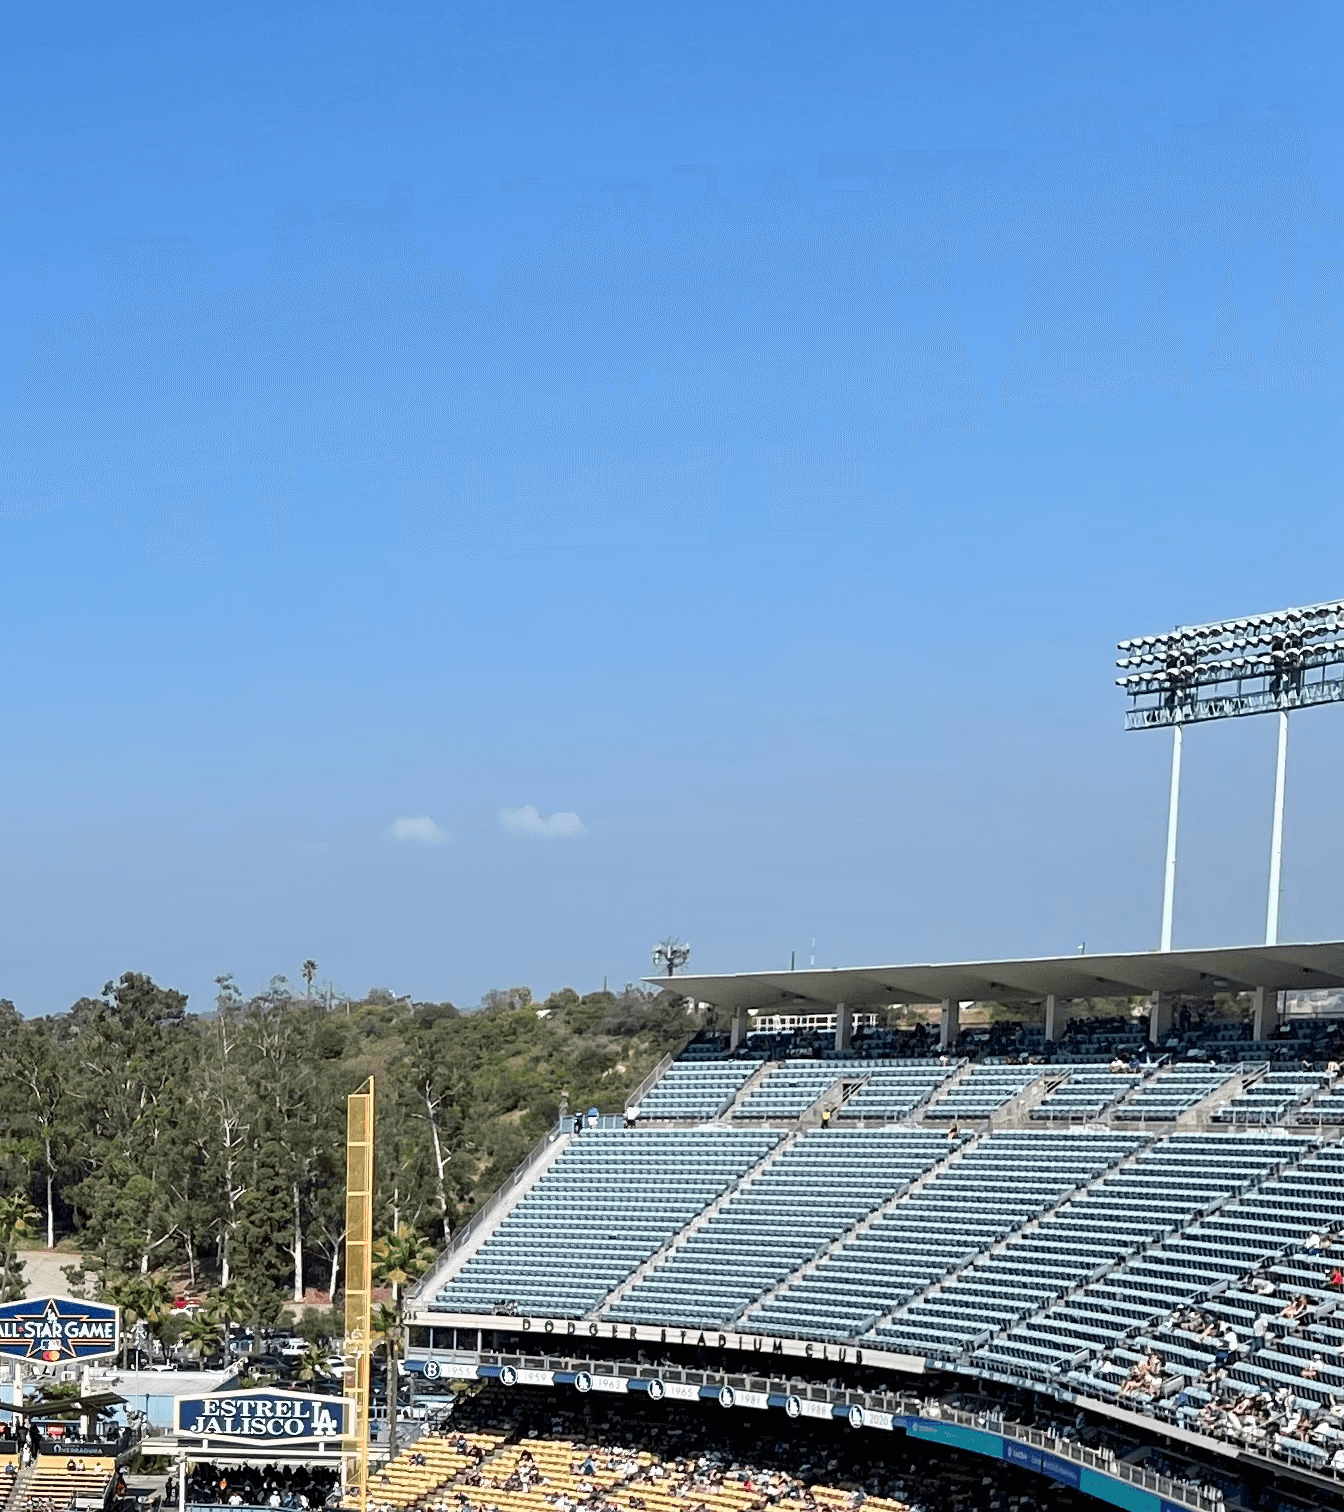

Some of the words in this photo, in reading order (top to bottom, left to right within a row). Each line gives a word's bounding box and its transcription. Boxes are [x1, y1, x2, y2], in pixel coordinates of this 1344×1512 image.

[24, 1321, 63, 1338] STAR
[65, 1321, 113, 1339] GAME
[522, 1318, 637, 1340] DODGER
[661, 1328, 784, 1355] STADIUM
[805, 1344, 864, 1365] CLUB
[446, 1366, 471, 1376] 1955
[523, 1372, 547, 1382] 1959
[597, 1378, 621, 1389] 1963
[670, 1385, 694, 1397] 1965
[740, 1393, 762, 1406] 1981
[189, 1418, 305, 1436] JALISCO
[869, 1414, 889, 1428] 2020
